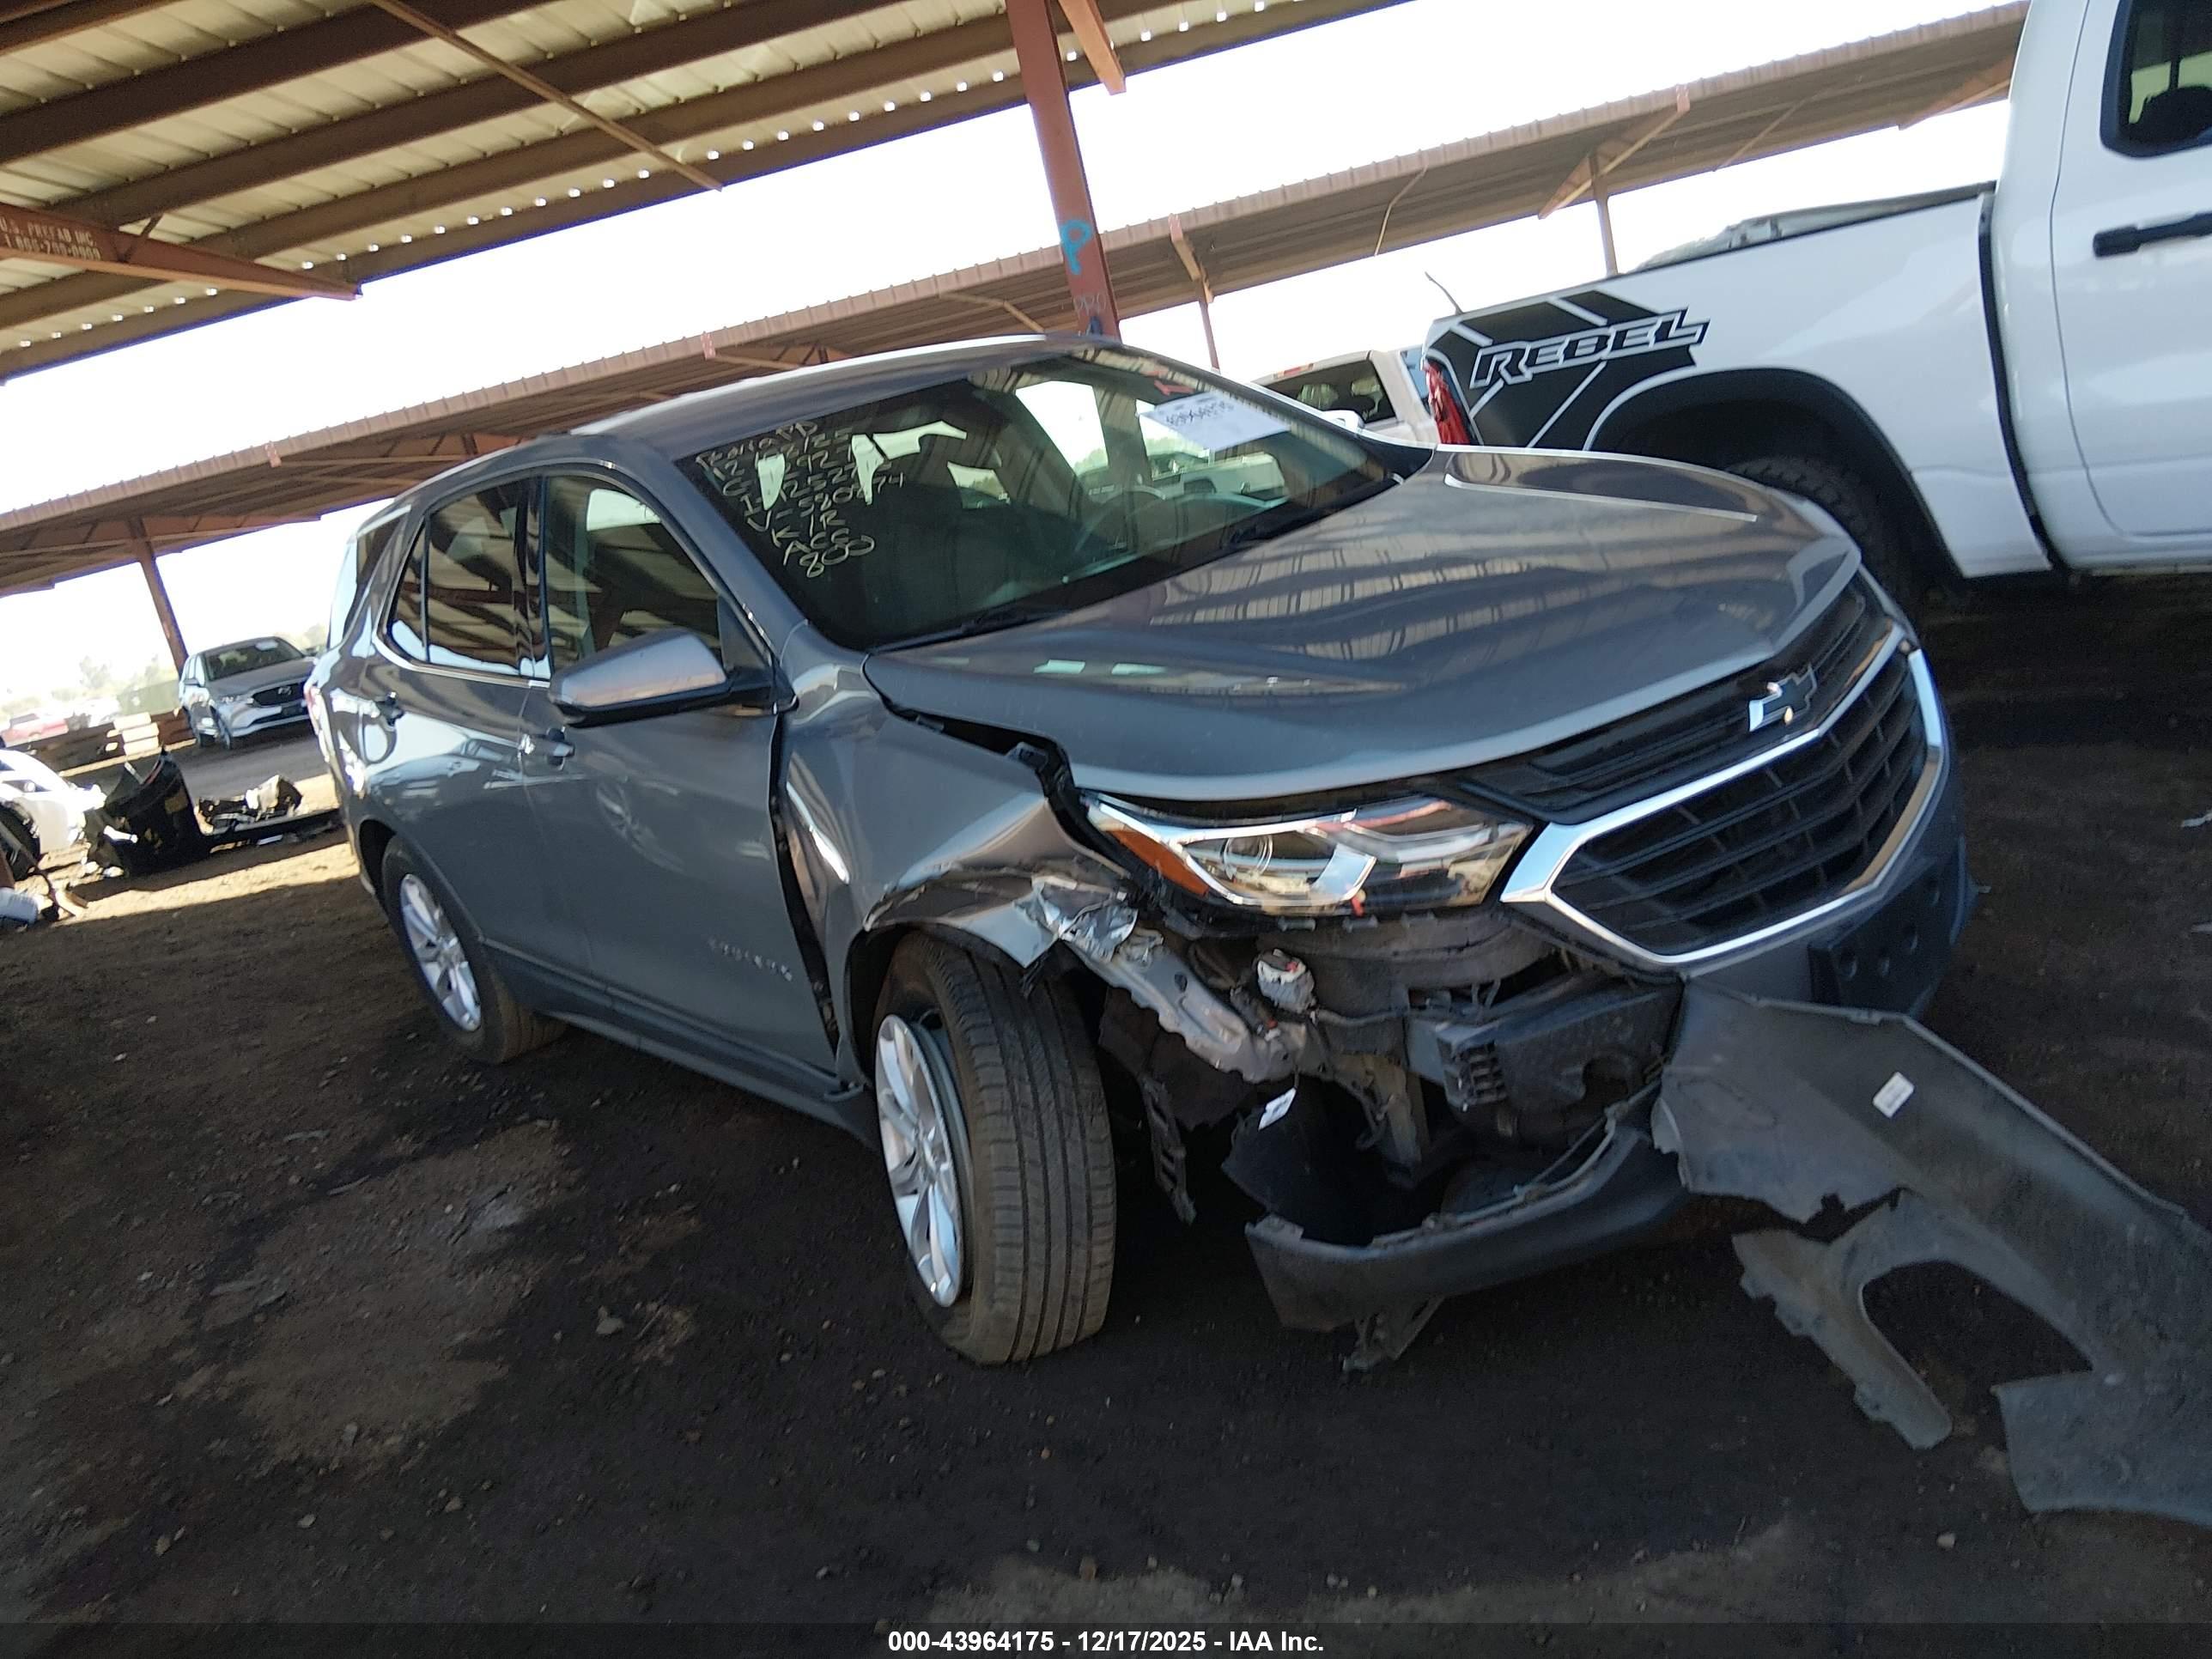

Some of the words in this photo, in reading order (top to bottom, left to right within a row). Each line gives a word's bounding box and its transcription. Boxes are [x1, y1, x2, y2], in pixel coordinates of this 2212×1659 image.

[1060, 220, 1092, 275] P
[1469, 307, 1711, 390] REBEL
[799, 535, 875, 578] 800
